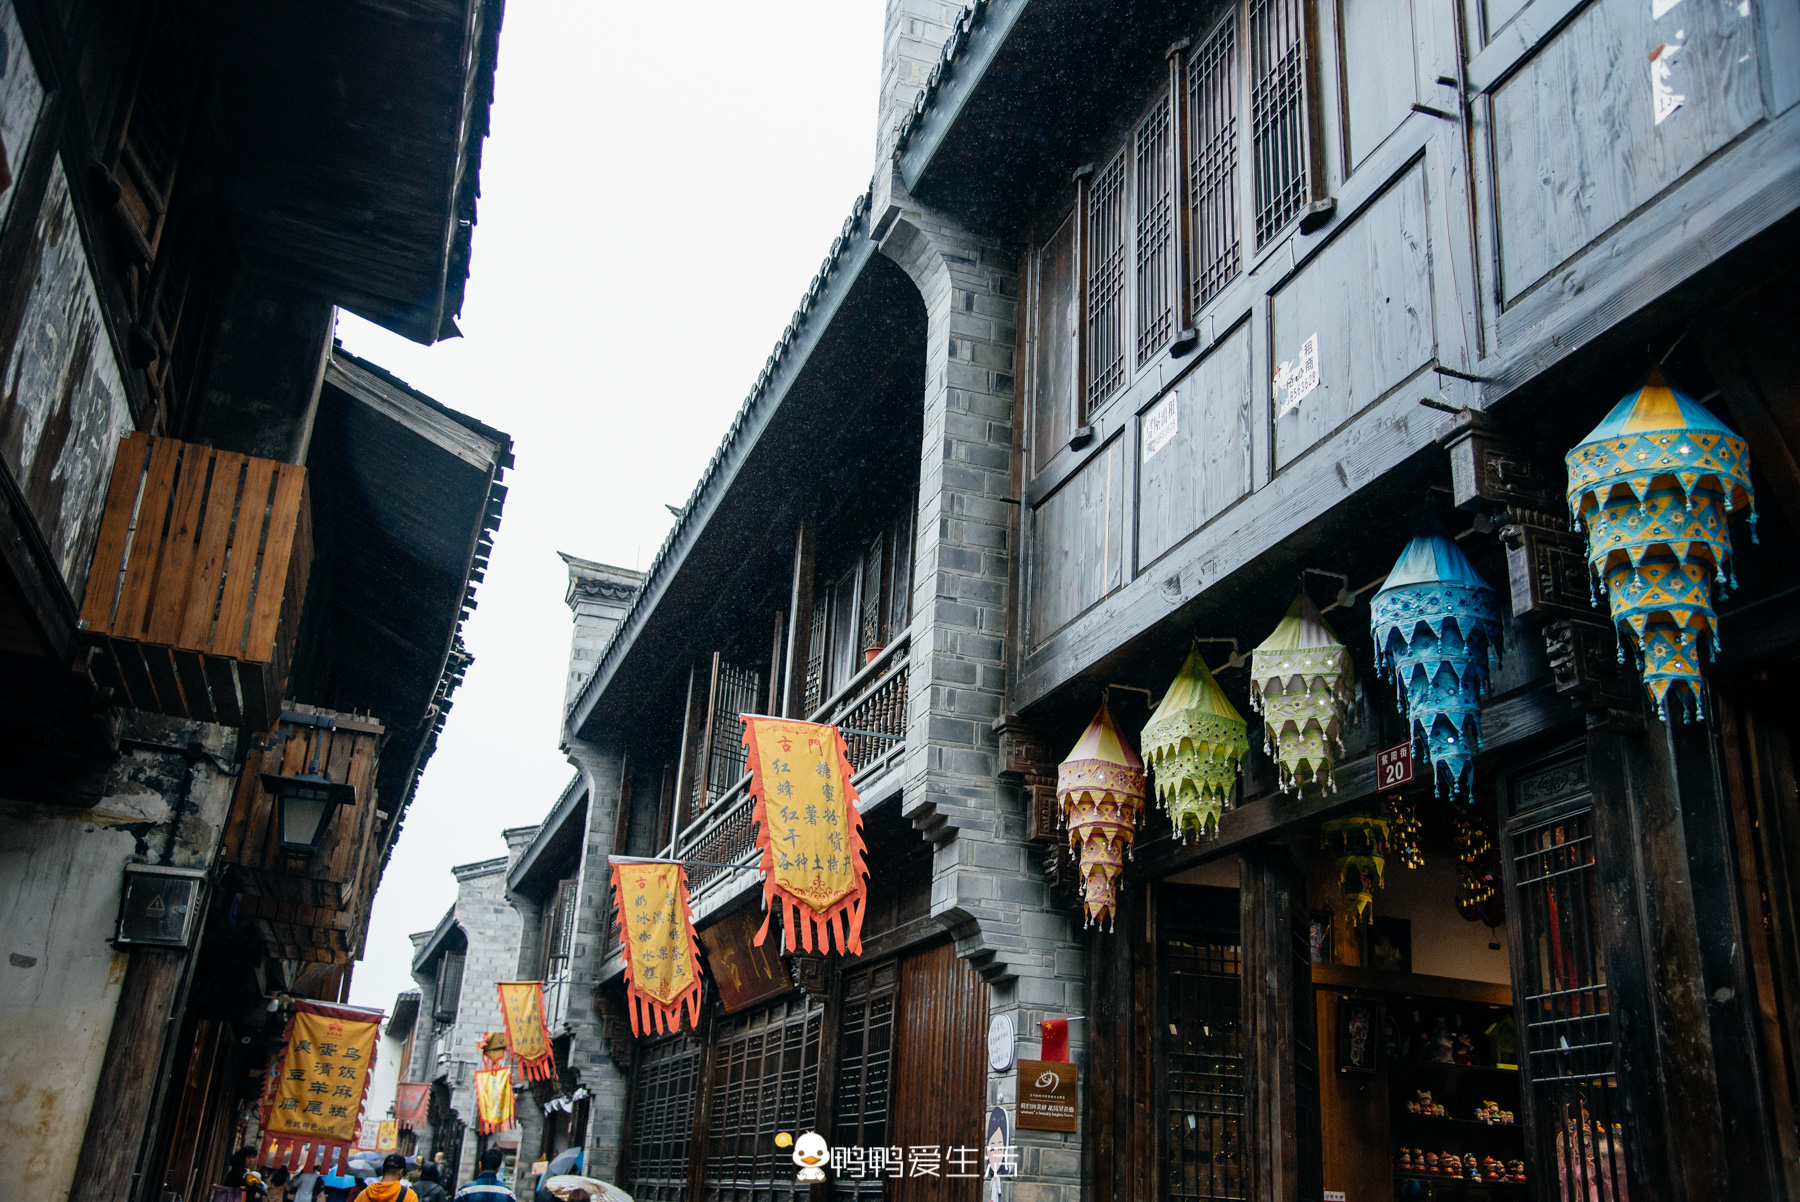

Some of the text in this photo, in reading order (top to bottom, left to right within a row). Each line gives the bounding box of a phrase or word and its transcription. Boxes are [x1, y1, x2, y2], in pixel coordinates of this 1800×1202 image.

[772, 758, 832, 780] 红糖
[1386, 761, 1404, 784] 20
[777, 781, 835, 803] 蜂蜜
[780, 804, 841, 827] 红薯粉
[783, 828, 844, 853] 干货
[779, 853, 850, 876] 各种土特产
[634, 891, 676, 908] 奶茶
[638, 927, 680, 943] 咖啡
[642, 945, 684, 962] 水果茶
[643, 964, 686, 980] 糕点
[278, 1039, 312, 1112] 臭豆腐
[302, 1042, 338, 1116] 蛋清羊尾
[328, 1047, 362, 1118] 乌饭麻糍
